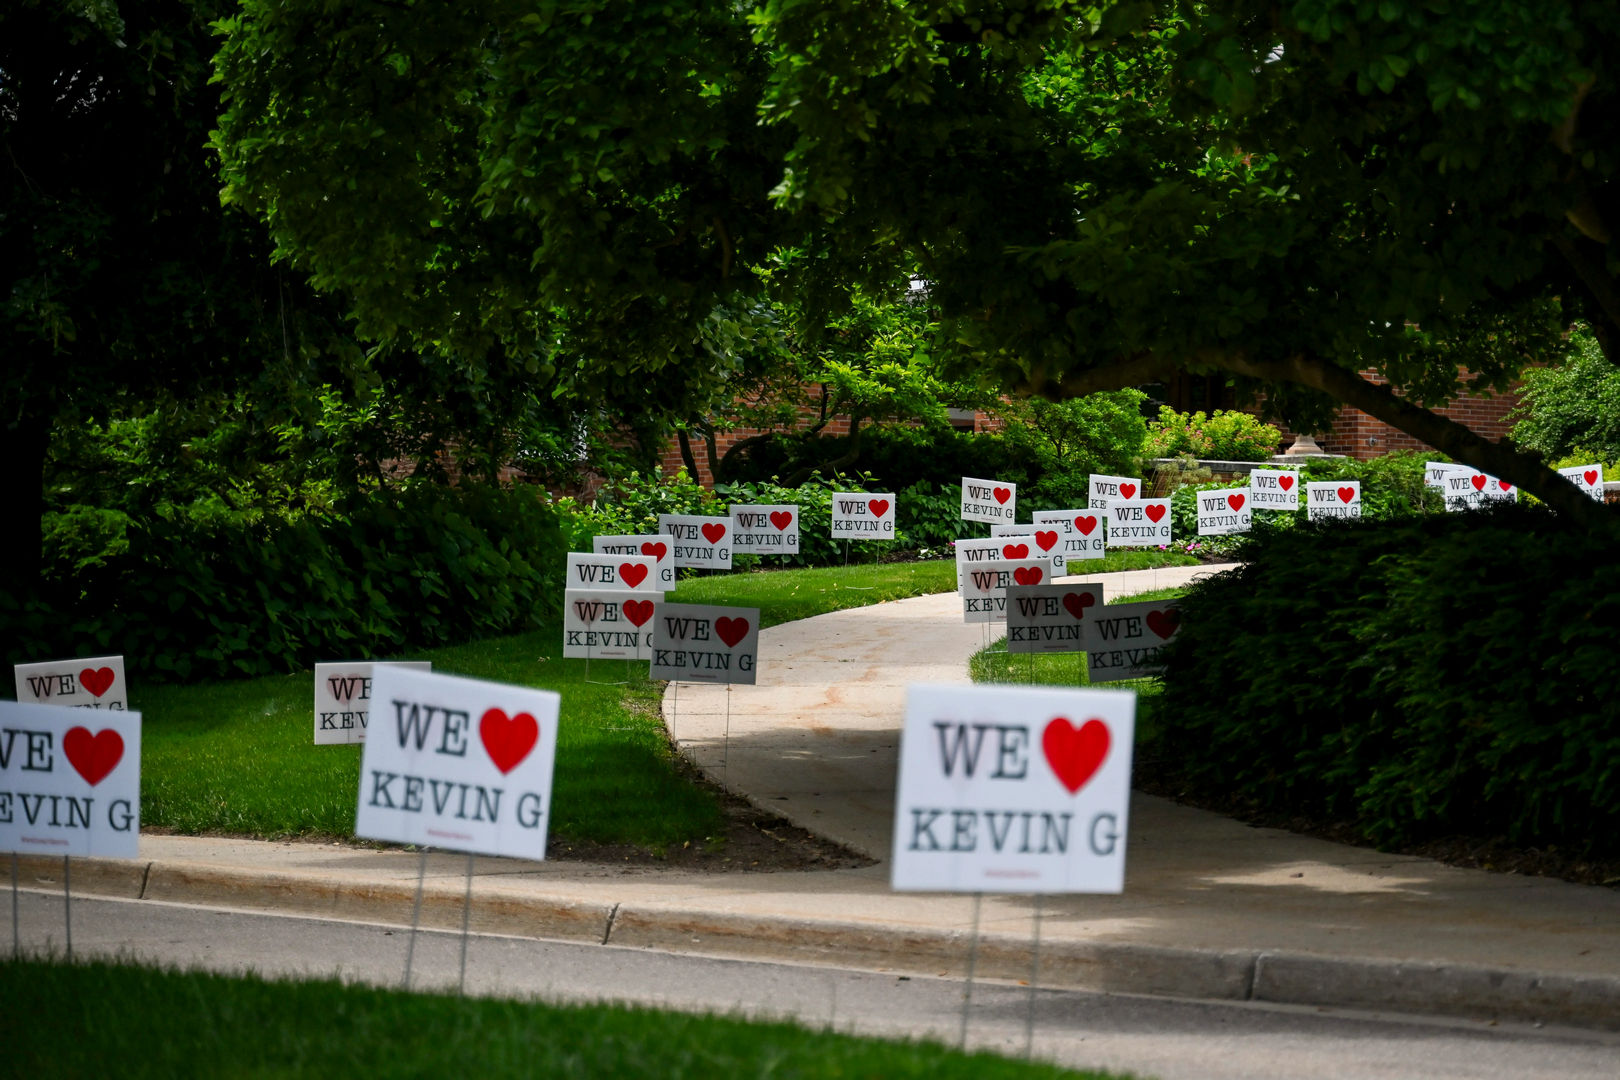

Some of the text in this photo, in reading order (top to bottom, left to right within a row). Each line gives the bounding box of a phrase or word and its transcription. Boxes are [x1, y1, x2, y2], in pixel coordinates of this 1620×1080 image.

[1095, 482, 1118, 496] WE
[1256, 476, 1277, 488] WE
[1449, 478, 1470, 490] WE
[968, 486, 992, 500] WE
[1253, 492, 1296, 504] KEVIN G
[1312, 489, 1336, 502] WE
[839, 501, 866, 515] WE
[964, 502, 1014, 518] KEVIN G
[1202, 498, 1226, 512] WE
[1310, 506, 1358, 518] KEVIN G
[736, 513, 767, 528] WE
[1115, 506, 1142, 521] WE
[1200, 514, 1250, 528] KEVIN G
[665, 523, 698, 540] WE
[834, 520, 892, 532] KEVIN G
[1110, 526, 1170, 538] KEVIN G
[732, 534, 797, 546] KEVIN G
[1092, 538, 1103, 550] G
[673, 546, 729, 560] EVIN G
[1054, 556, 1064, 568] G
[576, 564, 615, 583] WE
[661, 568, 672, 582] G
[970, 571, 1010, 590] WE
[574, 601, 618, 622] WE
[966, 598, 1007, 612] KEV
[1016, 596, 1059, 616] WE
[664, 617, 710, 640] WE
[1010, 625, 1081, 642] KEVIN
[1094, 616, 1143, 640] WE
[567, 631, 640, 648] KEVIN
[652, 649, 753, 672] KEVIN G
[26, 674, 76, 698] WE
[320, 711, 369, 731] KEV
[391, 699, 470, 758] WE
[932, 720, 1029, 780] WE
[368, 770, 543, 830] KEVIN G
[0, 791, 135, 832] EVIN G
[907, 807, 1121, 856] KEVIN G
